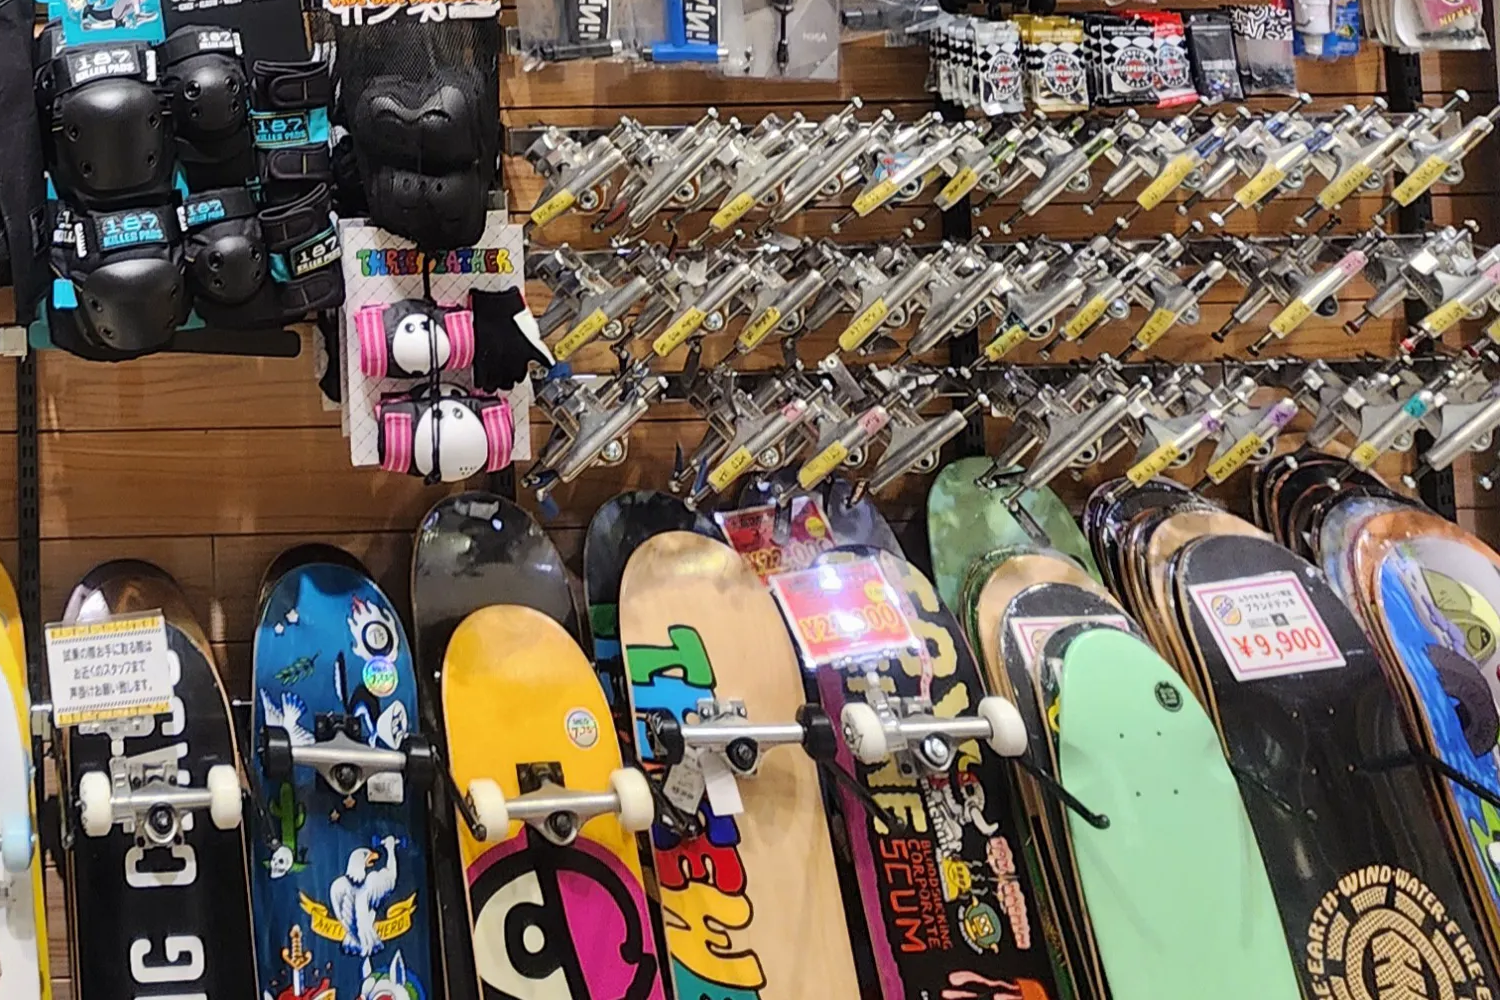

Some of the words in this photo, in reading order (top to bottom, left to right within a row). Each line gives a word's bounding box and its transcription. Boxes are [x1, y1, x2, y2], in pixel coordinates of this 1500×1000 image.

[78, 50, 132, 70] 187
[257, 118, 302, 134] 187
[102, 215, 158, 233] 187
[1231, 626, 1321, 660] ¥9,900
[879, 838, 927, 952] SCUM
[908, 838, 941, 949] CORPORATE
[312, 916, 345, 936] ANTI
[375, 912, 411, 939] HERO
[1306, 890, 1339, 975] EARTH
[1337, 864, 1392, 897] WIND
[1395, 867, 1446, 922] WATER
[1444, 919, 1485, 980] FIRE
